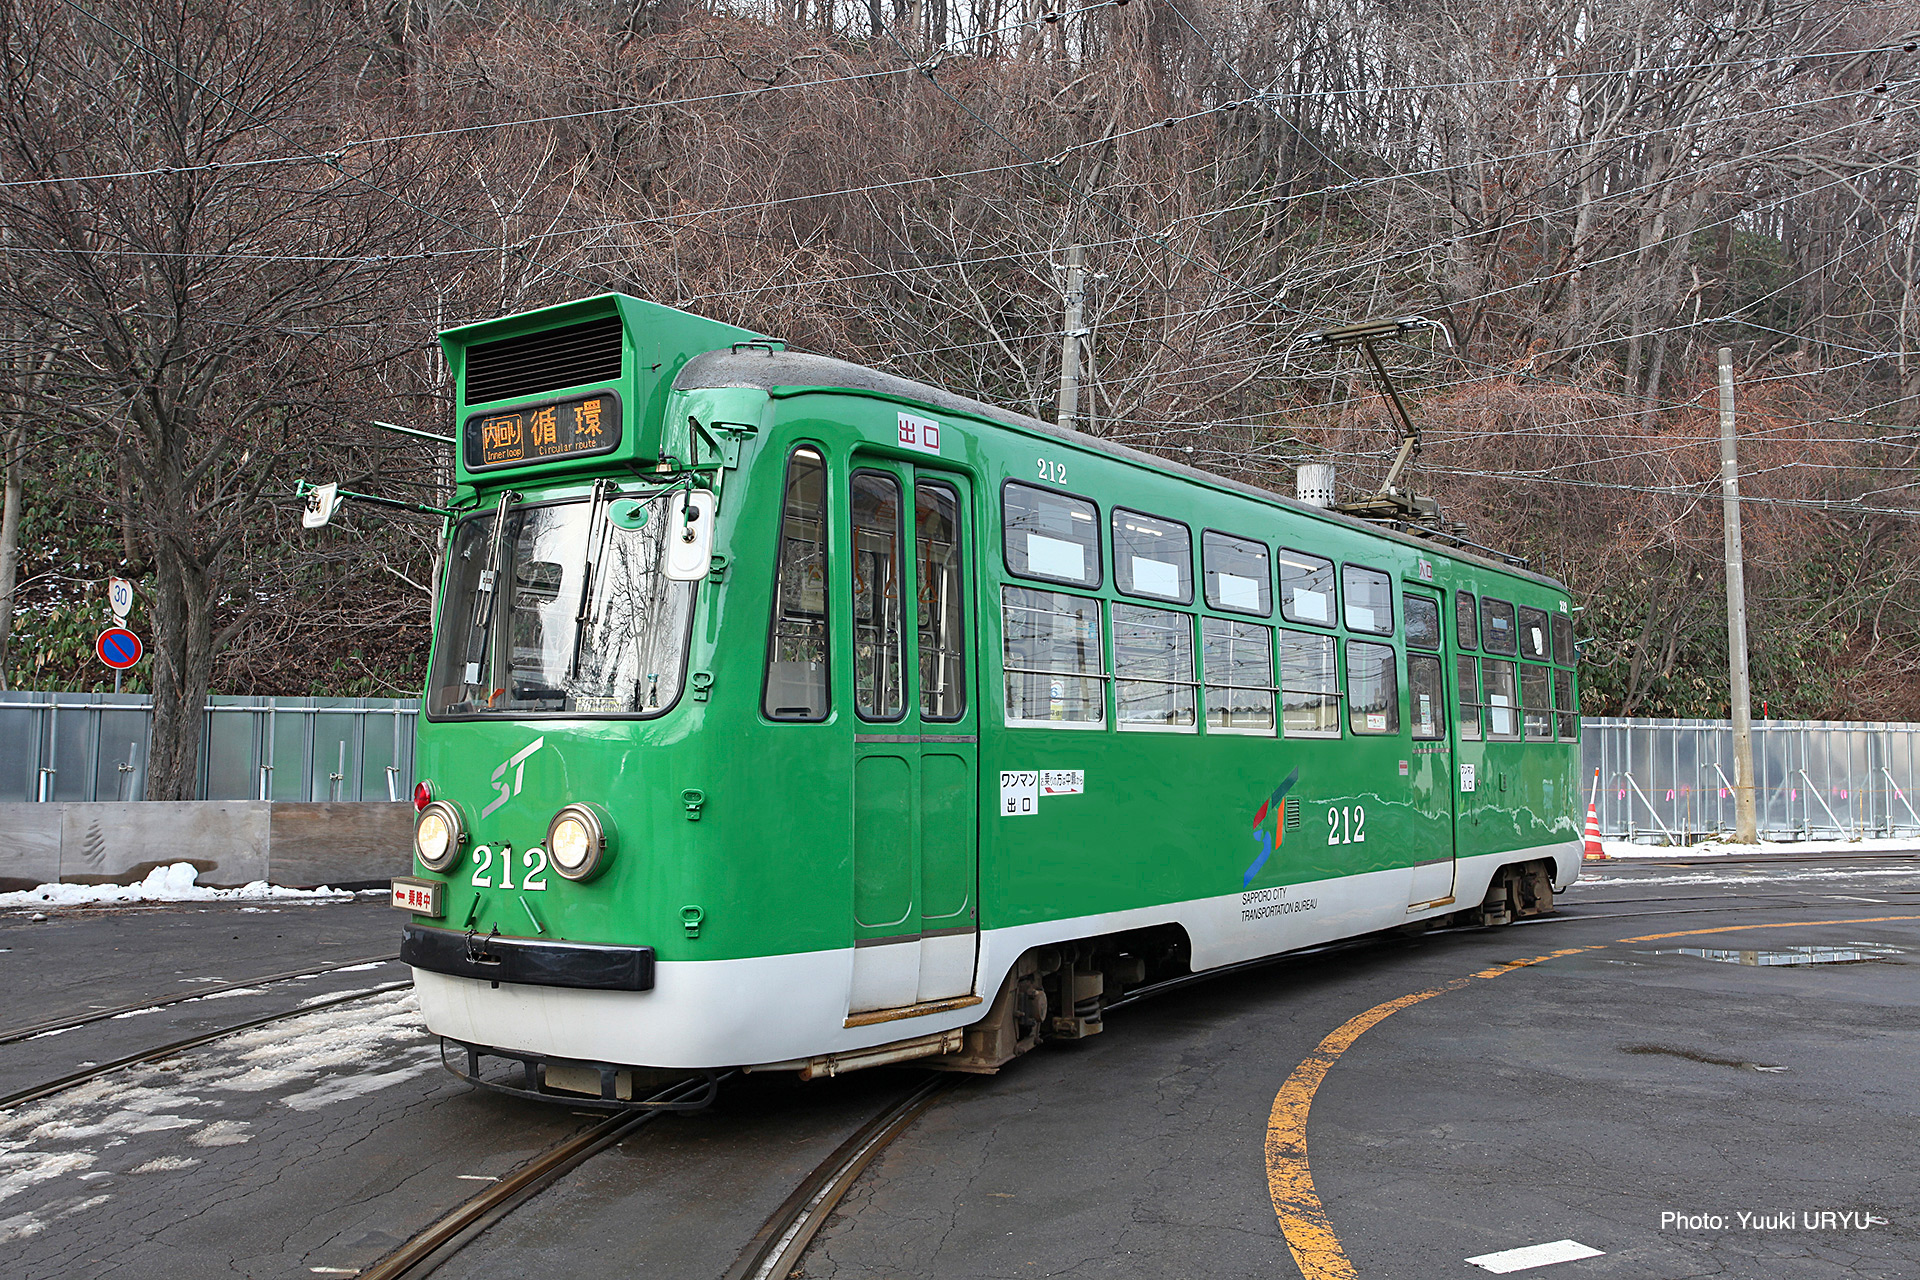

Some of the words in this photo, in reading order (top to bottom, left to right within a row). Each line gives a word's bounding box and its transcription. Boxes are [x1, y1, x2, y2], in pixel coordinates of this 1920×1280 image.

[484, 418, 521, 449] 内回り
[530, 400, 602, 446] 循環
[899, 420, 939, 449] 出口
[487, 449, 506, 461] Inner
[506, 448, 522, 458] loop
[539, 443, 572, 456] Circular
[575, 440, 597, 450] route
[1037, 457, 1067, 485] 212
[1419, 562, 1432, 578] 入口
[114, 584, 128, 606] 30
[1001, 773, 1037, 788] ワンマン
[1007, 797, 1031, 813] 出口
[1327, 805, 1365, 846] 212
[471, 844, 548, 891] 212
[408, 889, 431, 909] 乗降中
[1242, 889, 1272, 905] SAPPORO
[1273, 887, 1288, 900] CITY
[1241, 902, 1294, 922] TRANSPORTATION
[1294, 898, 1318, 913] BUREAU
